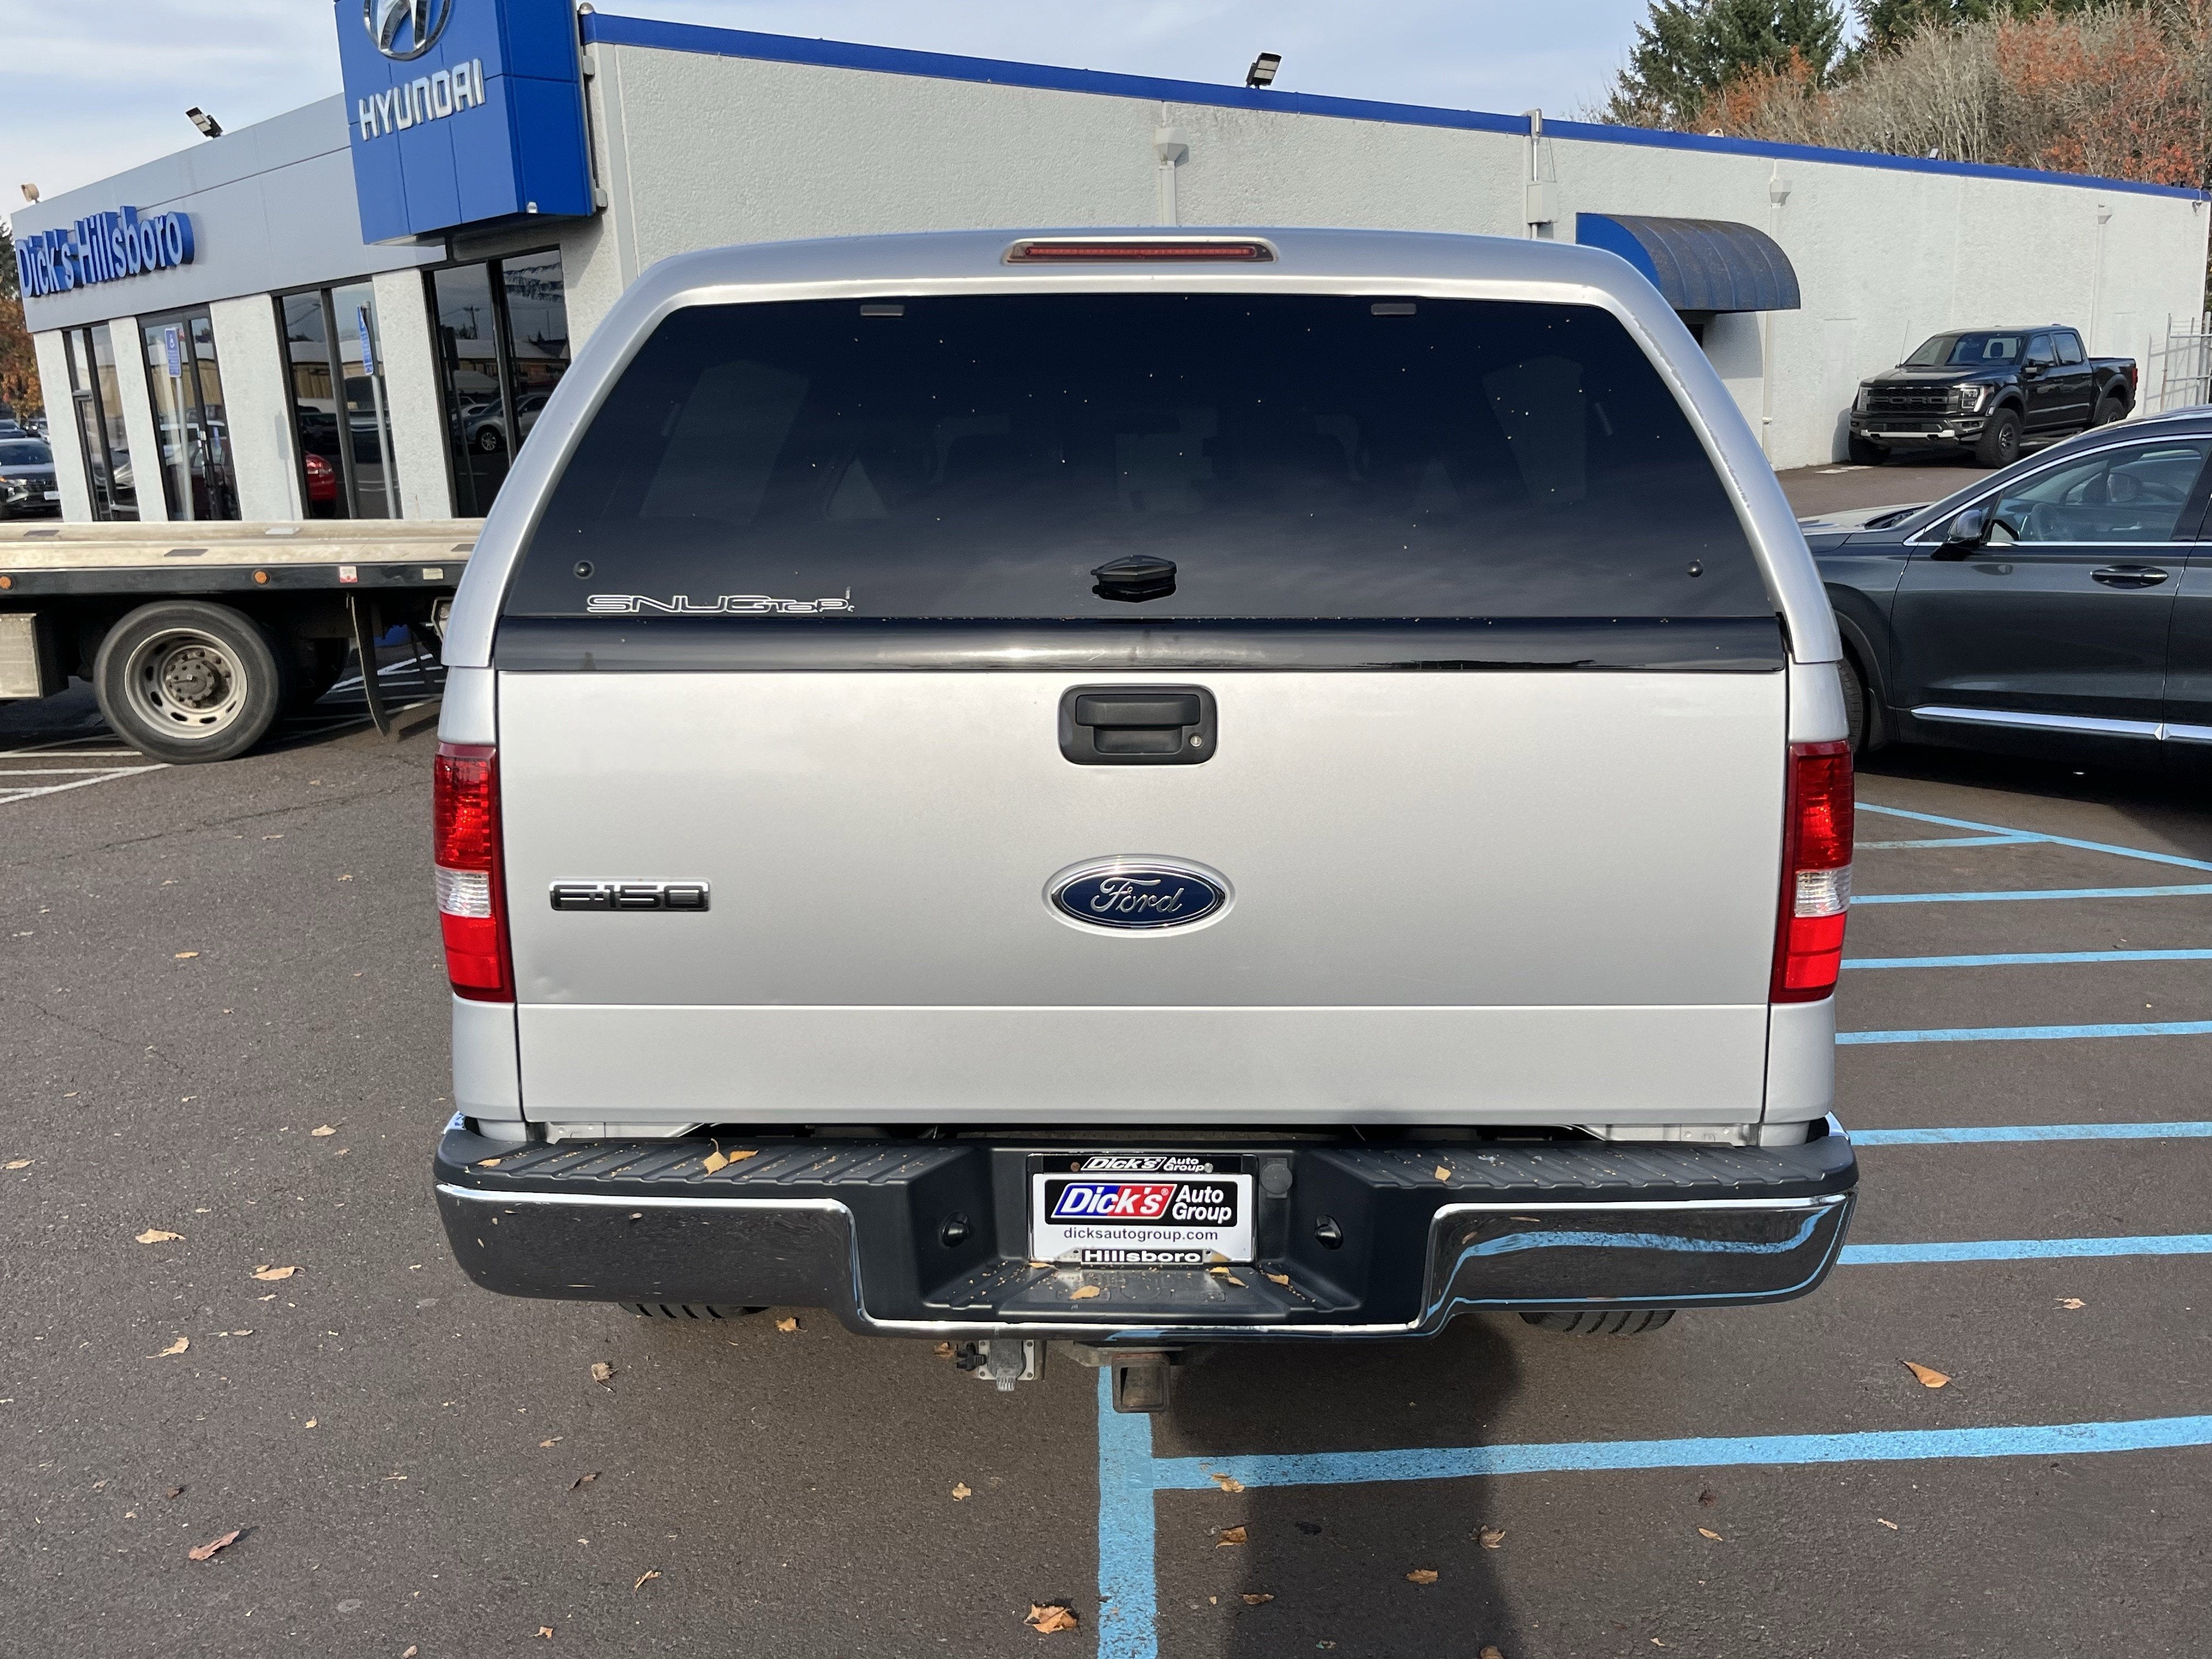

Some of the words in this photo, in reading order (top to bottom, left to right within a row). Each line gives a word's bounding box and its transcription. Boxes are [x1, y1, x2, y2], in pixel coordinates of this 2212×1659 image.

[358, 58, 486, 141] HYUNDAI
[15, 229, 74, 297] Dick's
[75, 206, 185, 284] Hillsboro
[1090, 877, 1184, 913] Ford
[1088, 1158, 1158, 1169] Dick's
[1163, 1163, 1205, 1172] Group
[1060, 1186, 1162, 1214] Dick's
[1175, 1184, 1224, 1204] Auto
[1172, 1203, 1232, 1224] Group
[1063, 1227, 1218, 1242] dicksautogroup.com
[1084, 1250, 1201, 1263] Hillsboro
